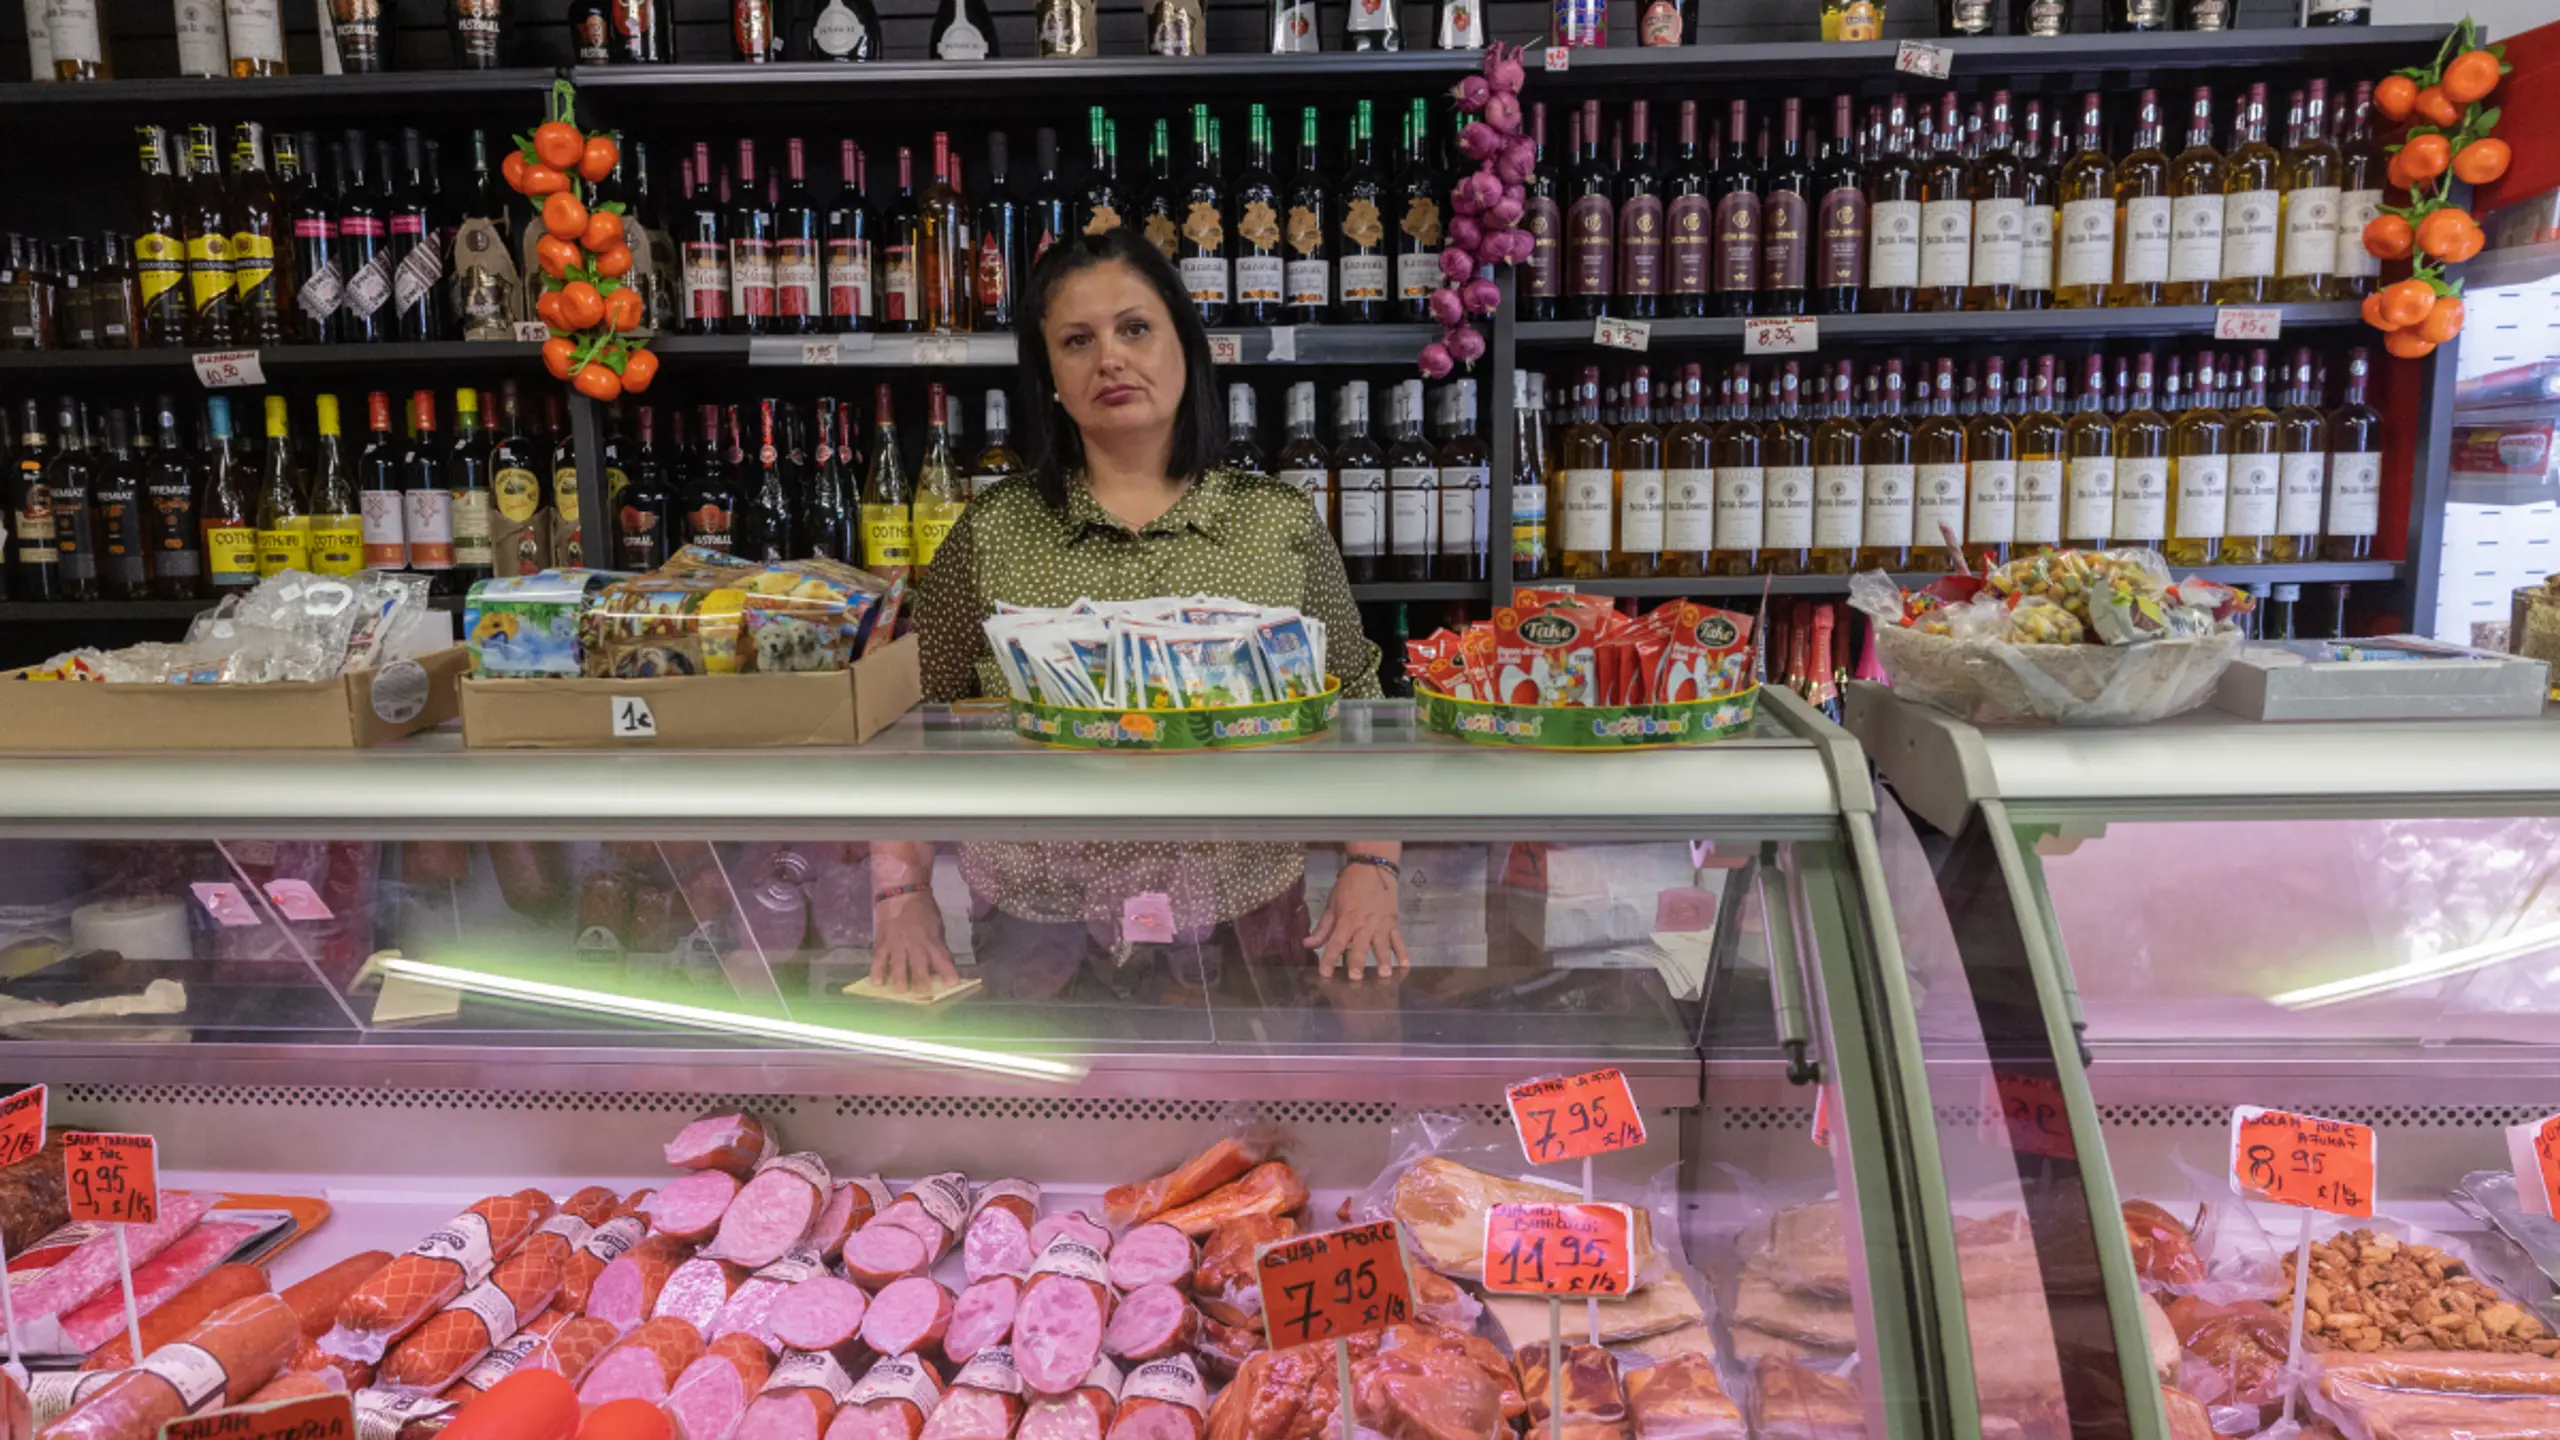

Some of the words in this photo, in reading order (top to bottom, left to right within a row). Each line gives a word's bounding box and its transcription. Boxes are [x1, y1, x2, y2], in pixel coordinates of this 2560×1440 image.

[1525, 621, 1572, 639] Take
[1527, 1096, 1608, 1158] 7,95
[72, 1164, 129, 1215] 9,95
[2246, 1145, 2327, 1191] 8,95
[1330, 1222, 1397, 1250] PORC
[1282, 1258, 1378, 1340] 7,95
